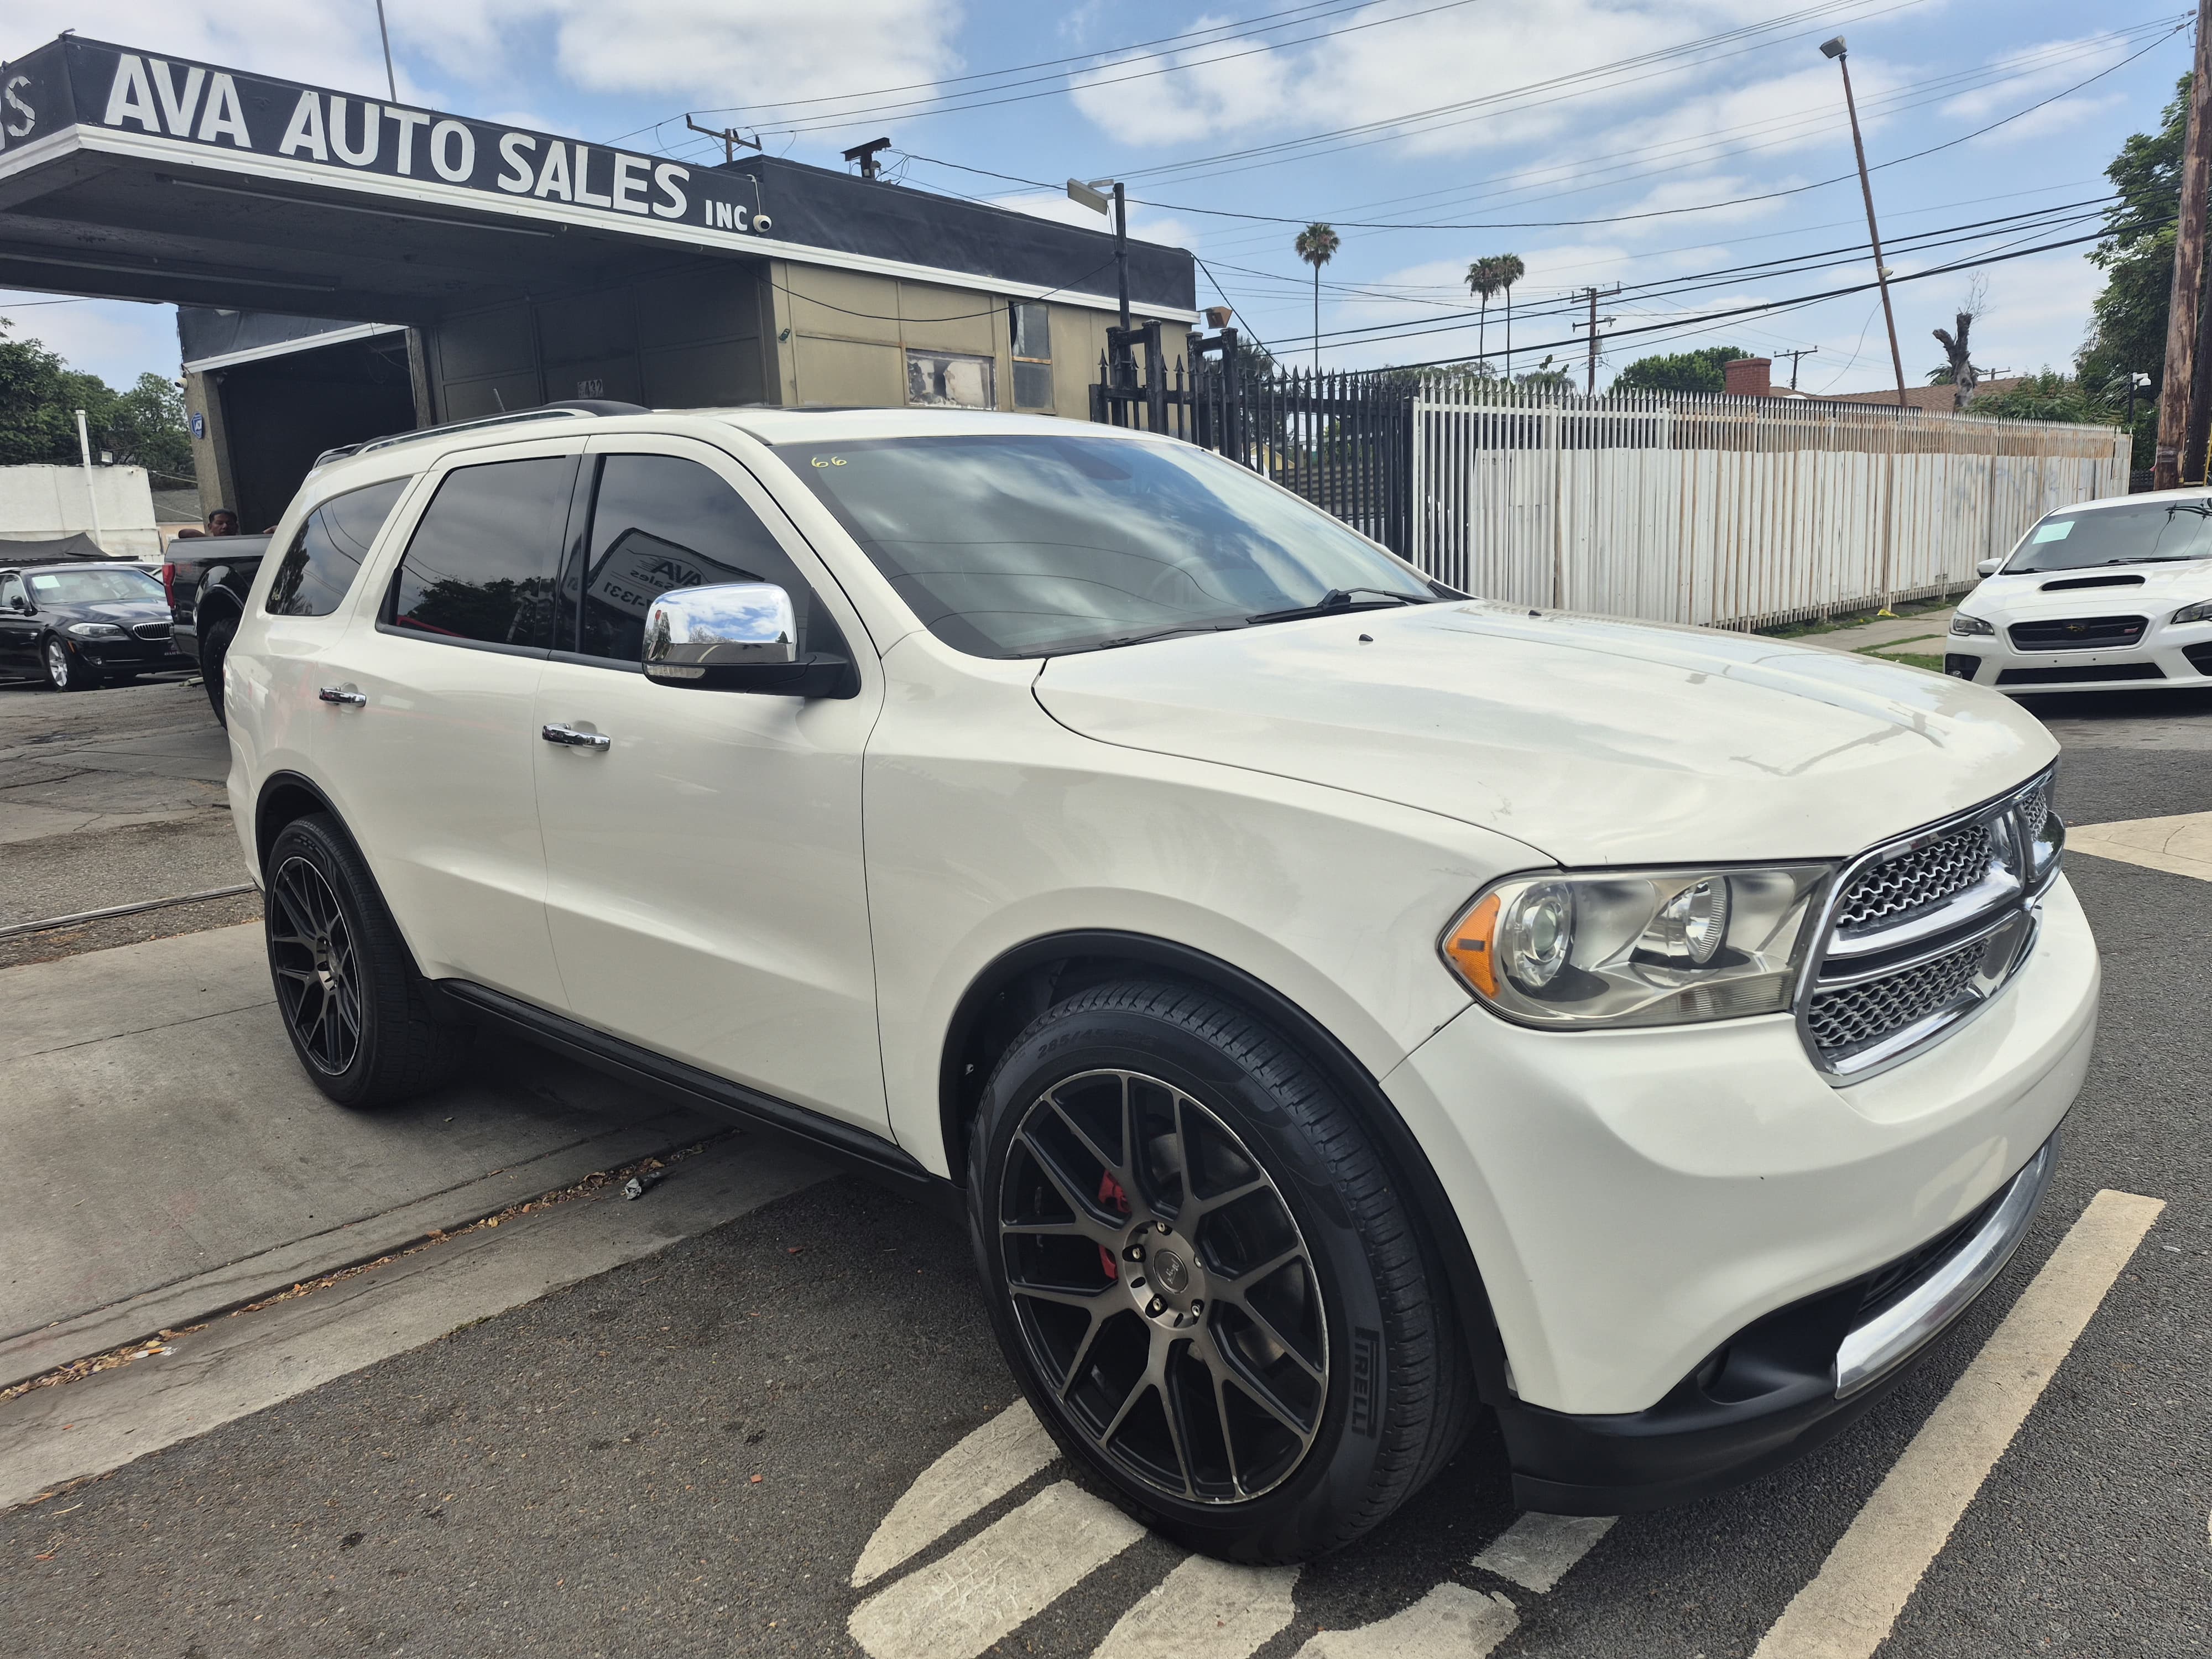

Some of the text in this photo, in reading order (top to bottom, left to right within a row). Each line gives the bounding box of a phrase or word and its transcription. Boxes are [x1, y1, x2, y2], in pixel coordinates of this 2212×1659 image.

[103, 53, 748, 232] AVA AUTO SALES INC
[811, 456, 847, 467] 66
[1352, 1326, 1380, 1440] PIRELLI
